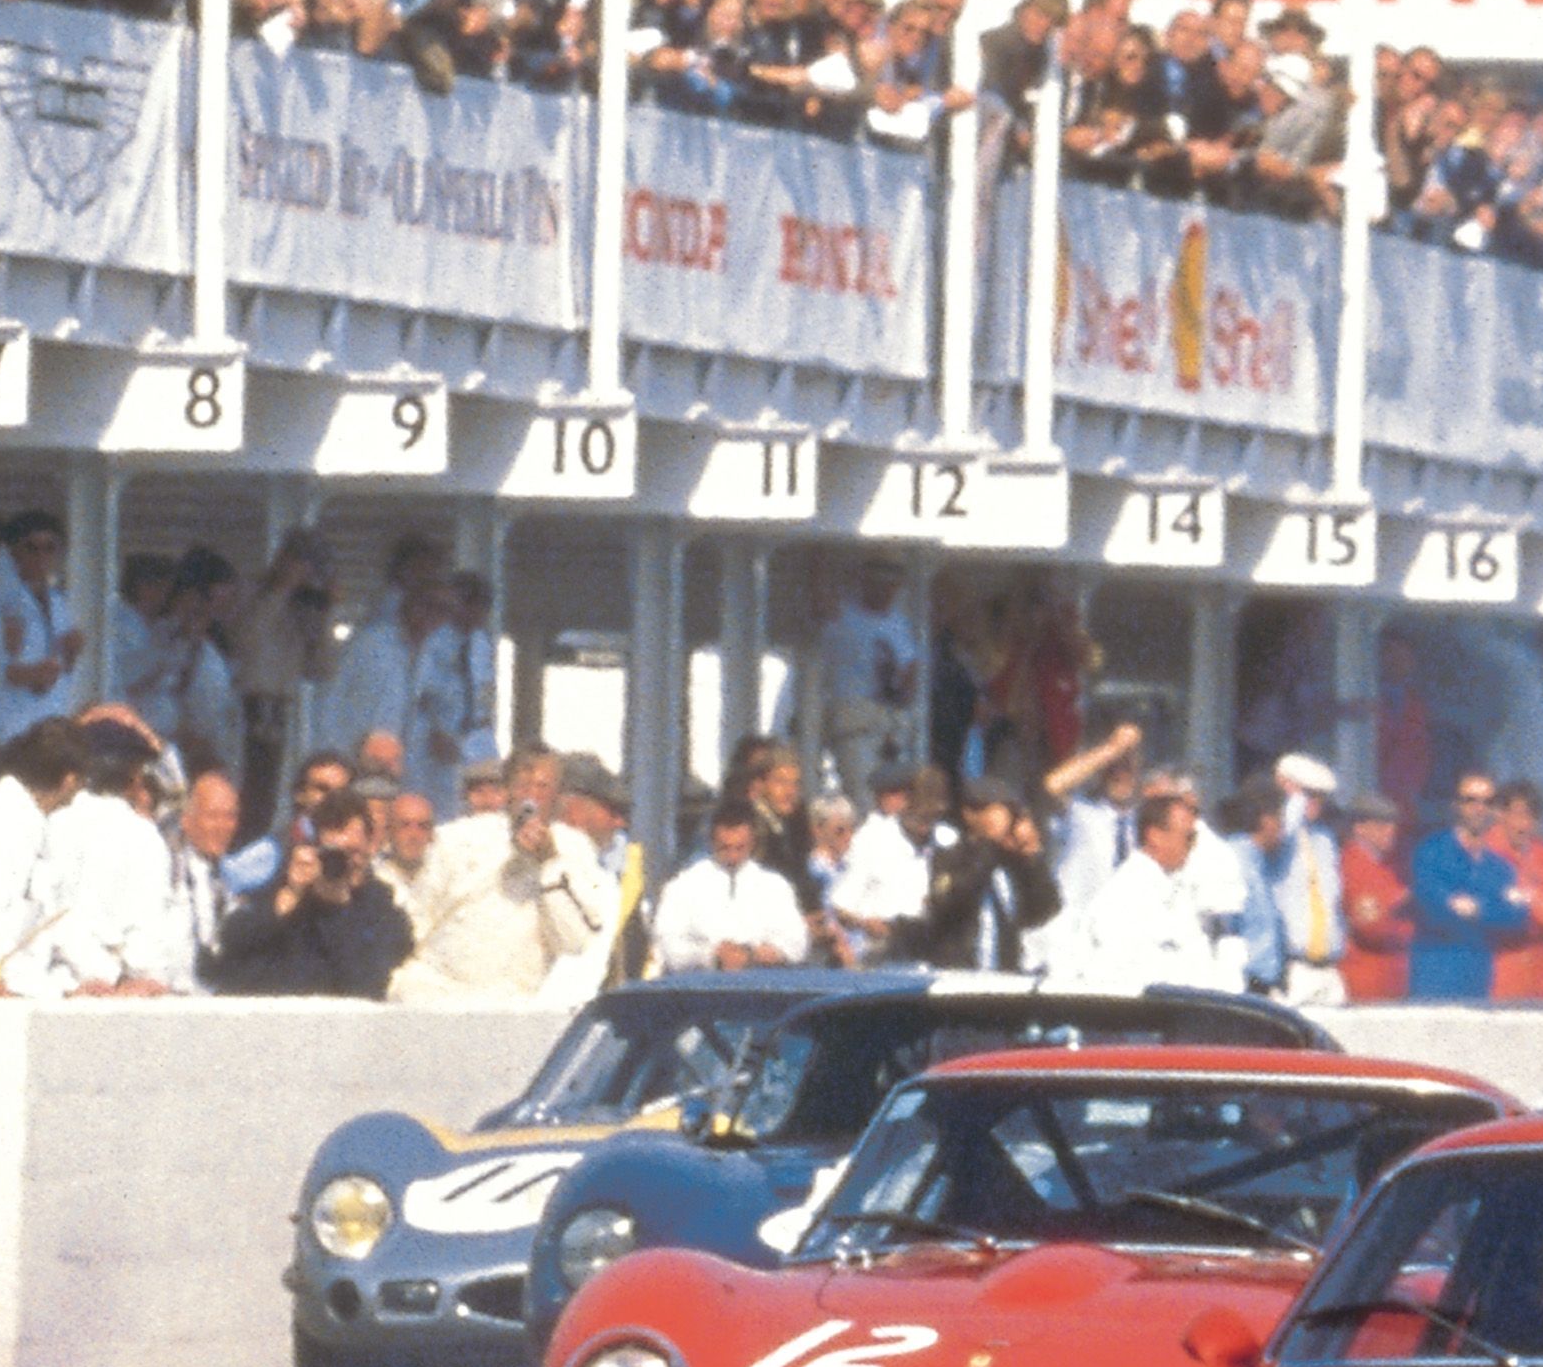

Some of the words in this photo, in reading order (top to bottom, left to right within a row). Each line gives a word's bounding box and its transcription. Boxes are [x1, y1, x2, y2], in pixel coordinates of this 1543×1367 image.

[185, 369, 220, 429] 8
[391, 394, 426, 452] 9
[552, 418, 616, 476] 10
[762, 441, 798, 497] 11
[912, 464, 969, 518] 12
[1147, 490, 1204, 544] 14
[1307, 514, 1357, 565] 15
[1447, 531, 1500, 581] 16
